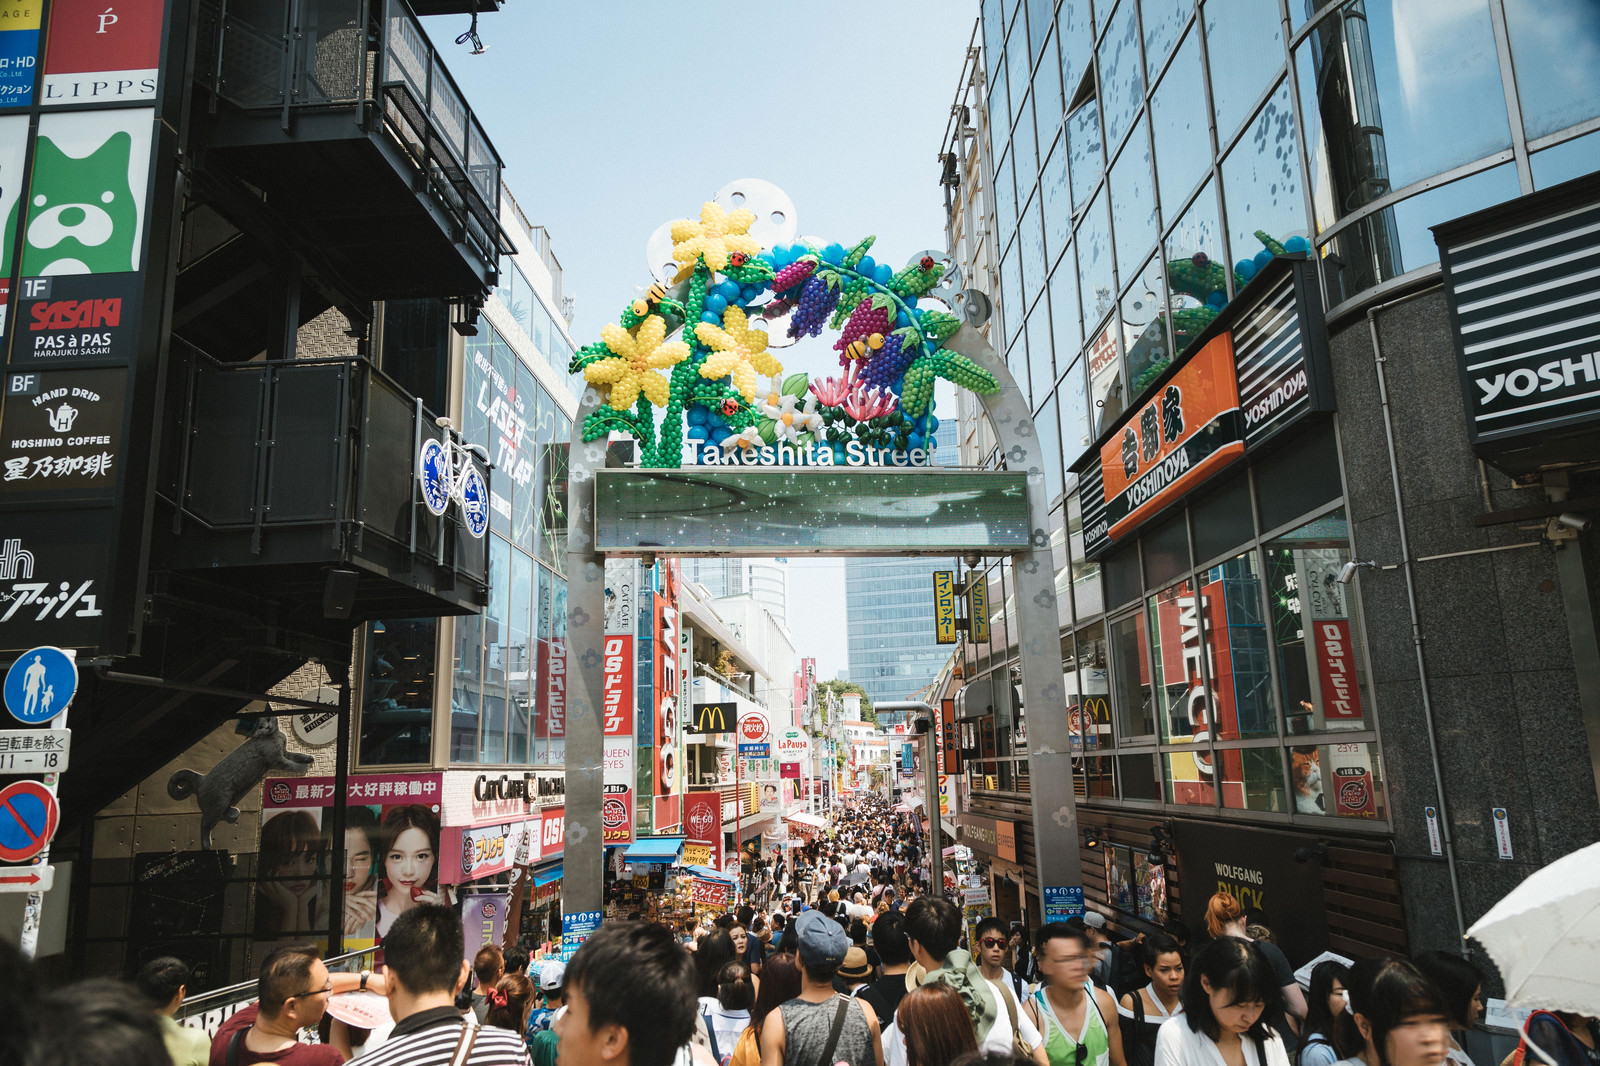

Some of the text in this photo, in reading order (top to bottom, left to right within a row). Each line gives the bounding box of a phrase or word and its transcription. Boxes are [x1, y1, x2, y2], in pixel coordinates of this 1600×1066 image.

[45, 79, 156, 99] LIPPS
[24, 279, 47, 297] 1F
[29, 298, 122, 331] SASAKI
[33, 347, 110, 358] HARAJUKU SASAKI
[35, 333, 112, 349] PAS à PAS
[11, 375, 35, 392] BF
[32, 387, 101, 407] HAND DRIP
[477, 380, 527, 448] LASER
[1244, 372, 1308, 429] YOSHINOYA
[11, 435, 110, 449] HOSHINO COFFEE
[1121, 384, 1184, 480] 吉野家
[3, 451, 114, 481] 星乃珈琲
[496, 436, 534, 488] TRAP
[684, 438, 937, 467] Takeshita Street
[1126, 447, 1190, 511] YOSHINOYA
[0, 580, 103, 622] アッシュ
[621, 584, 630, 603] CAT
[938, 572, 953, 635] コインロッカー
[605, 640, 625, 732] OSドラッグ
[661, 606, 677, 788] WEGO
[0, 735, 65, 751] 自転車を除く
[543, 817, 565, 847] OS
[476, 836, 504, 862] プリクラ
[1214, 862, 1263, 885] WOLFGANG
